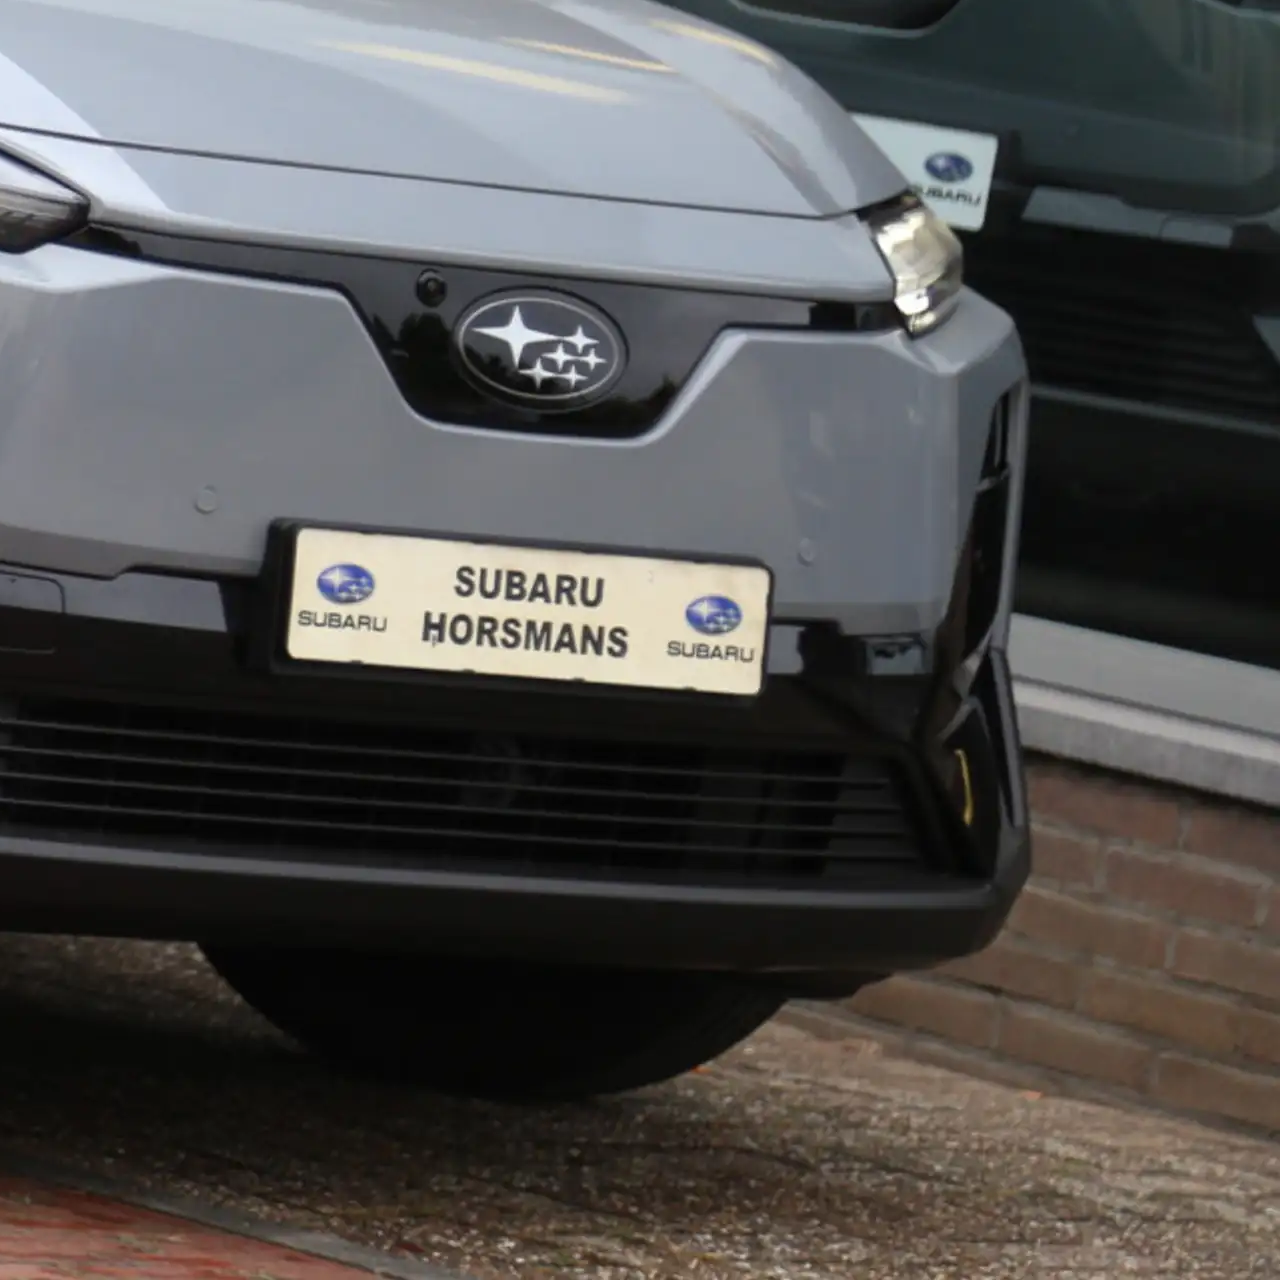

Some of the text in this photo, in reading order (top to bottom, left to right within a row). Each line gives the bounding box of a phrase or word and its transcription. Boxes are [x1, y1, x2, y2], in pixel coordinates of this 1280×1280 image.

[453, 565, 605, 608] SUBARU
[298, 609, 388, 633] SUBARU
[421, 611, 629, 658] HORSMANS
[667, 640, 756, 663] SUBARU
